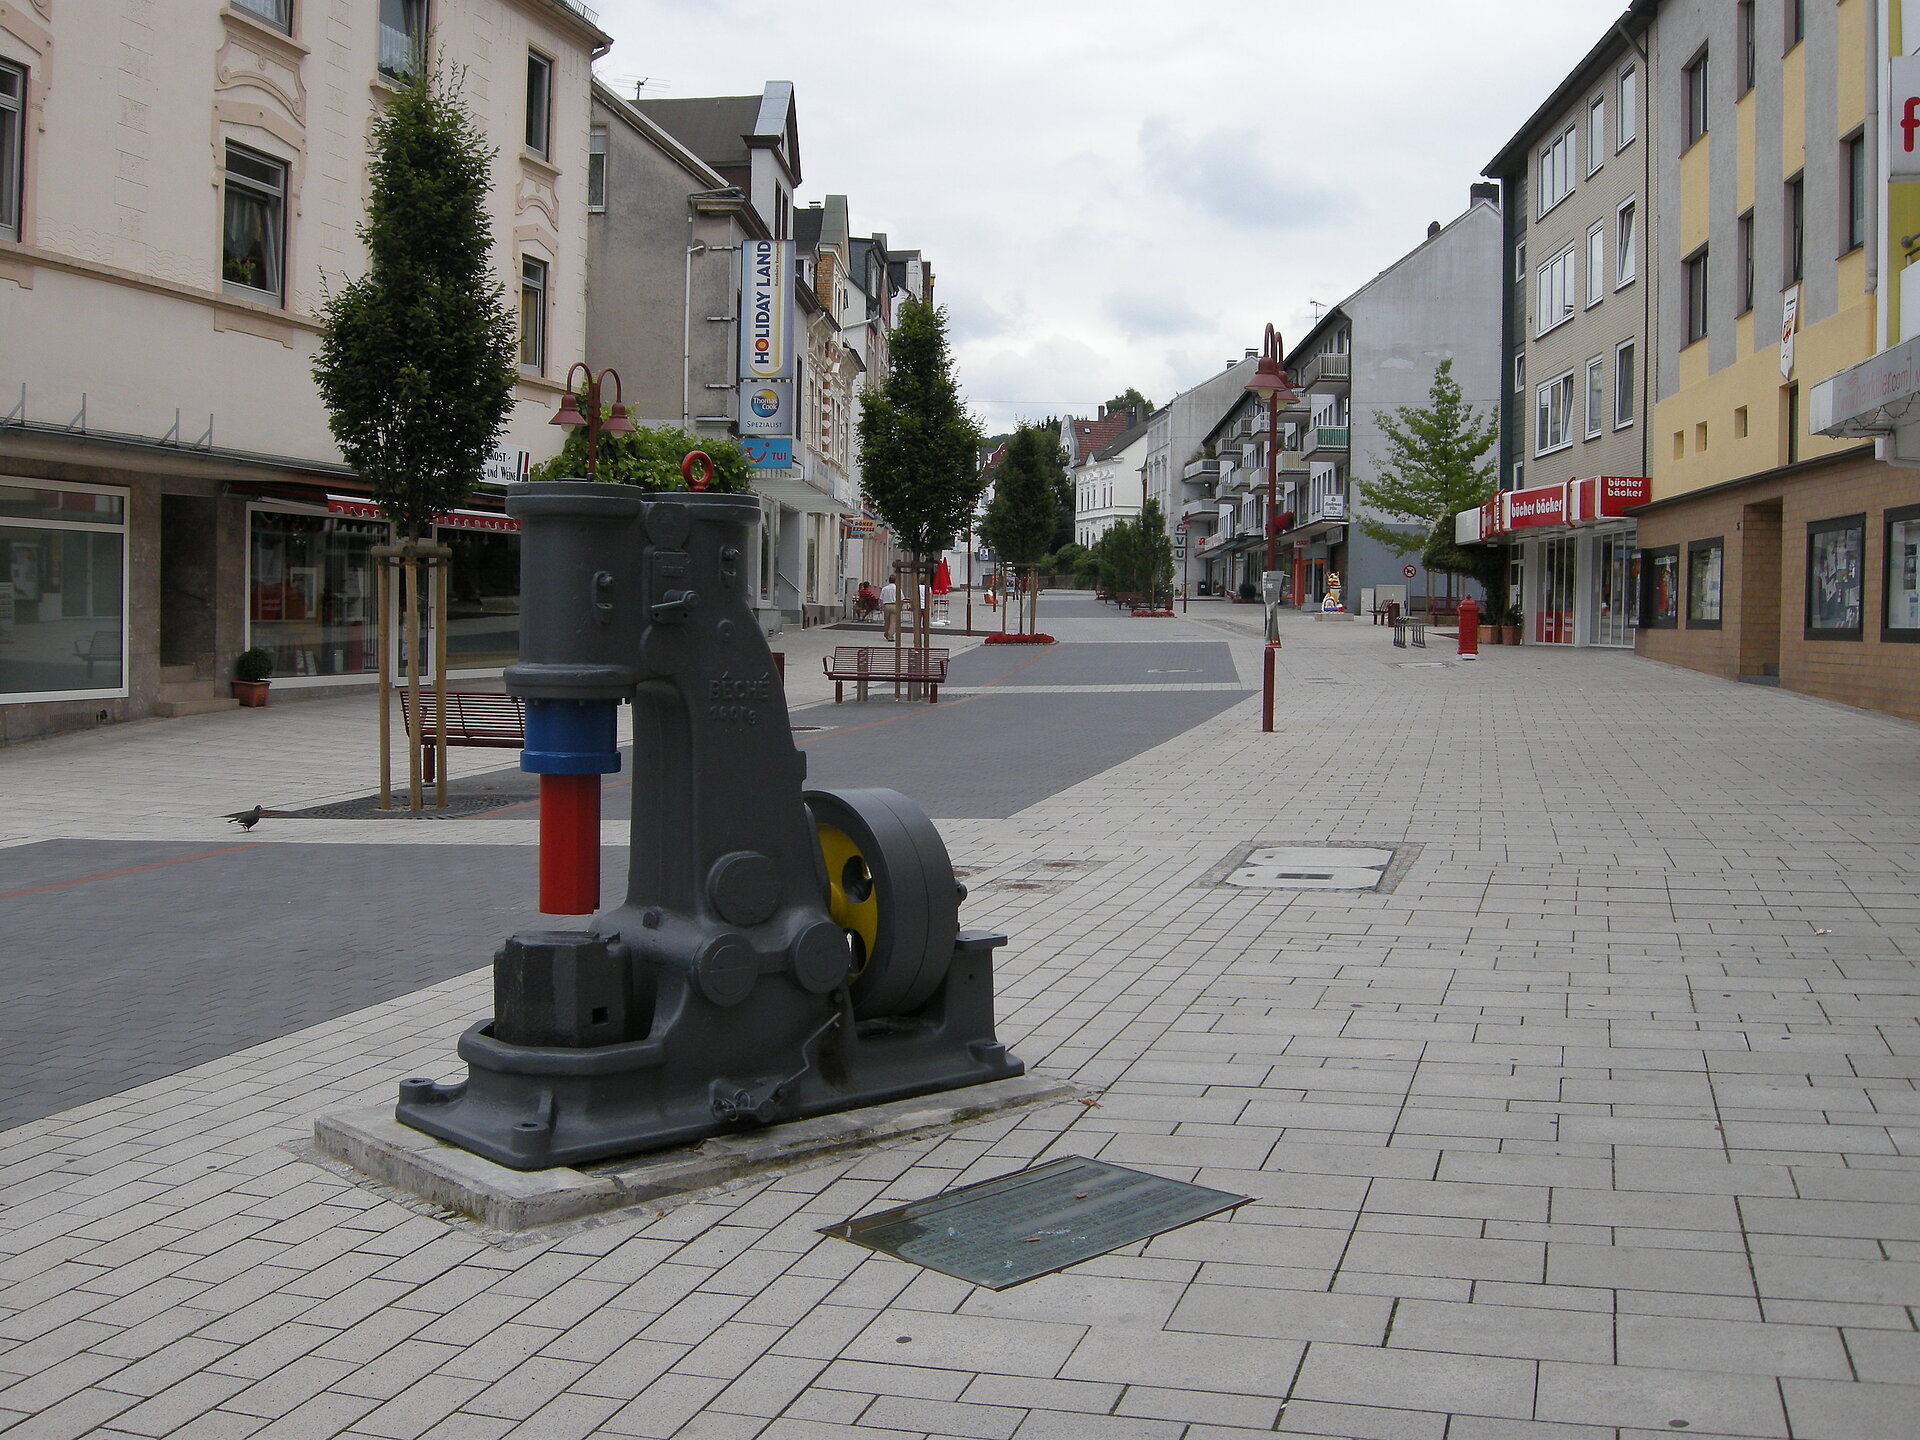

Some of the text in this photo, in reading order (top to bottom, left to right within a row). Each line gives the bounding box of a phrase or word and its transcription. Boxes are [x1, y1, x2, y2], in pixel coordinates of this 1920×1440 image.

[754, 240, 772, 364] HOLIDAY LAND
[771, 452, 787, 460] TUI
[1608, 478, 1643, 487] bücher
[1607, 488, 1643, 497] bäcker
[1511, 503, 1535, 518] bücher
[1536, 497, 1562, 514] bäcker
